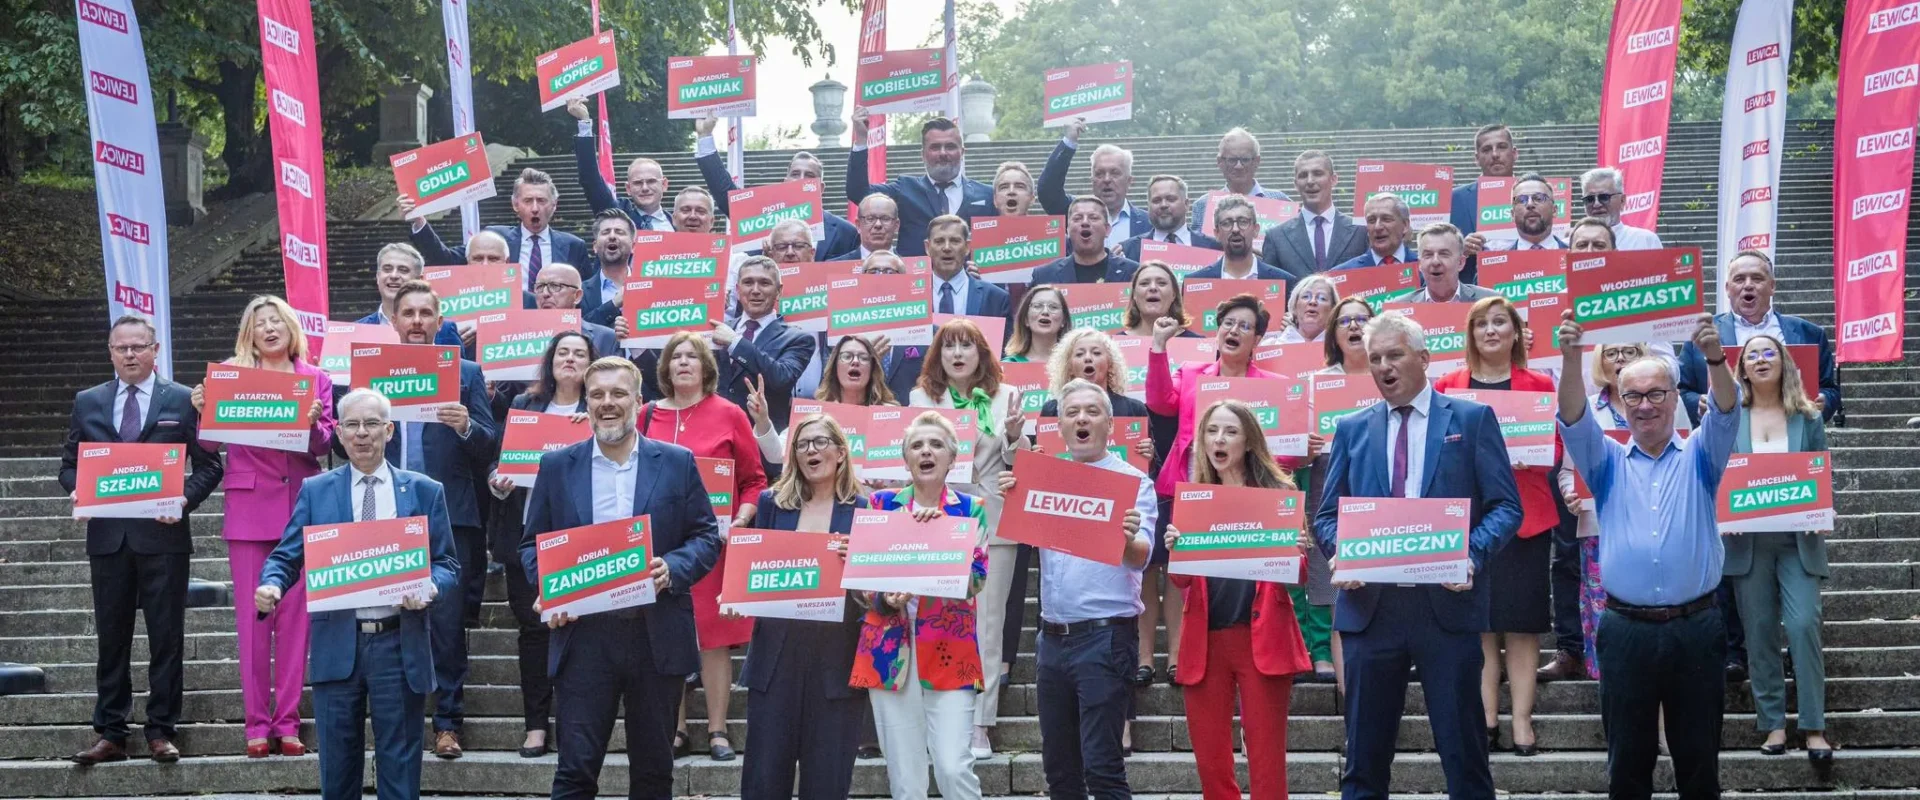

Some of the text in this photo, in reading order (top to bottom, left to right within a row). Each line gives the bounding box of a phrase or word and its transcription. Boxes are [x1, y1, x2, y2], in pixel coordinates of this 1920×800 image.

[1871, 5, 1919, 31] LEWICA
[1630, 29, 1671, 50] LEWICA
[1748, 45, 1779, 64] LEWICA
[562, 56, 588, 73] MACIEJ
[554, 61, 599, 91] KOPIEC
[691, 72, 731, 84] ARKADIUSZ
[889, 68, 913, 78] PAWEŁ
[864, 74, 939, 98] KOBIELUSZ
[1075, 82, 1097, 92] JACEK
[1867, 68, 1916, 93] LEWICA
[680, 81, 742, 101] IWANIAK
[1050, 85, 1123, 110] CZERNIAK
[1626, 84, 1664, 106] LEWICA
[1621, 138, 1660, 161] LEWICA
[1860, 131, 1911, 155] LEWICA
[1744, 142, 1769, 159] LEWIC
[426, 159, 453, 175] MACIEJ
[418, 165, 469, 194] GDULA
[1480, 181, 1505, 189] LEWICA
[1378, 184, 1427, 192] KRZYSZTOF
[731, 193, 754, 203] LEWICA
[1624, 195, 1653, 213] WICA
[1855, 193, 1902, 216] LEWICA
[740, 204, 811, 235] WOŹNIAK
[974, 221, 997, 229] LEWICA
[1004, 235, 1029, 245] JACEK
[659, 252, 701, 261] KRZYSZTOF
[976, 241, 1058, 265] JABŁOŃSKI
[1482, 256, 1508, 265] LEWICA
[1573, 258, 1605, 270] LEWICA
[1850, 254, 1894, 278] LEWICA
[644, 260, 713, 277] ŚMISZEK
[1512, 270, 1545, 281] MARCIN
[458, 284, 485, 295] MAREK
[832, 279, 857, 288] LEWICA
[1187, 283, 1212, 292] LEWICA
[1496, 277, 1563, 297] KULASEK
[1600, 273, 1668, 293] WŁODZIMIERZ
[651, 298, 694, 309] ARKADIUSZ
[862, 294, 897, 304] TADEUSZ
[1531, 298, 1557, 307] LEWICA
[1576, 284, 1694, 318] CZARZASTY
[480, 314, 506, 323] LEWICA
[639, 307, 703, 327] SIKORA
[832, 305, 927, 325] TOMASZEWSKI
[1424, 325, 1456, 337] ARIUSZ
[1845, 318, 1893, 340] LEWICA
[500, 329, 554, 343] STANISŁAW
[354, 349, 381, 357] LEWICA
[485, 338, 549, 361] SZAŁAJ
[1256, 350, 1283, 360] LEWICA
[212, 371, 239, 379] LEWICA
[389, 366, 417, 377] PAWEŁ
[373, 378, 435, 395] KRUTUL
[1202, 382, 1229, 391] LEWICA
[1317, 380, 1344, 389] LEWICA
[234, 393, 283, 401] KATARZYNA
[1355, 397, 1382, 407] ANITA
[218, 405, 296, 419] UEBERHAN
[873, 411, 900, 420] LEWICA
[1501, 424, 1554, 434] ĘCKIEWICZ
[542, 442, 569, 451] ANITA
[84, 449, 109, 458] LEWICA
[502, 452, 544, 461] KUCHAR
[1726, 458, 1748, 468] WICA
[112, 465, 149, 476] ANDRZEJ
[99, 475, 160, 494] SZEJNA
[1747, 474, 1798, 488] MARCELINA
[1182, 491, 1212, 500] LEWICA
[1733, 484, 1813, 508] ZAWISZA
[1030, 494, 1107, 518] LEWICA
[1343, 503, 1374, 513] LEWICA
[856, 514, 888, 523] LEWICA
[1209, 521, 1263, 532] AGNIESZKA
[1370, 523, 1433, 538] WOJCIECH
[308, 530, 338, 542] LEWICA
[731, 535, 761, 544] LEWICA
[1177, 531, 1295, 547] DZIEMIANOWICZ-BĄK
[541, 536, 568, 550] LEWICA
[887, 542, 929, 552] JOANNA
[1341, 532, 1462, 559] KONIECZNY
[331, 543, 401, 565] WALDERMAR
[576, 547, 610, 565] ADRIAN
[851, 551, 963, 564] SCHEURING-WIELGUS
[308, 550, 424, 589] WITKOWSKI
[750, 558, 820, 571] MAGDALENA
[1264, 560, 1291, 568] GDYNIA
[1403, 563, 1459, 575] CZĘSTOCHOWA
[547, 551, 641, 594] ZANDBERG
[751, 570, 818, 590] BIEJAT
[378, 582, 424, 597] BOLESŁAWIEC
[609, 582, 647, 600] WARSZAWA
[796, 601, 837, 609] WARSZAWA
